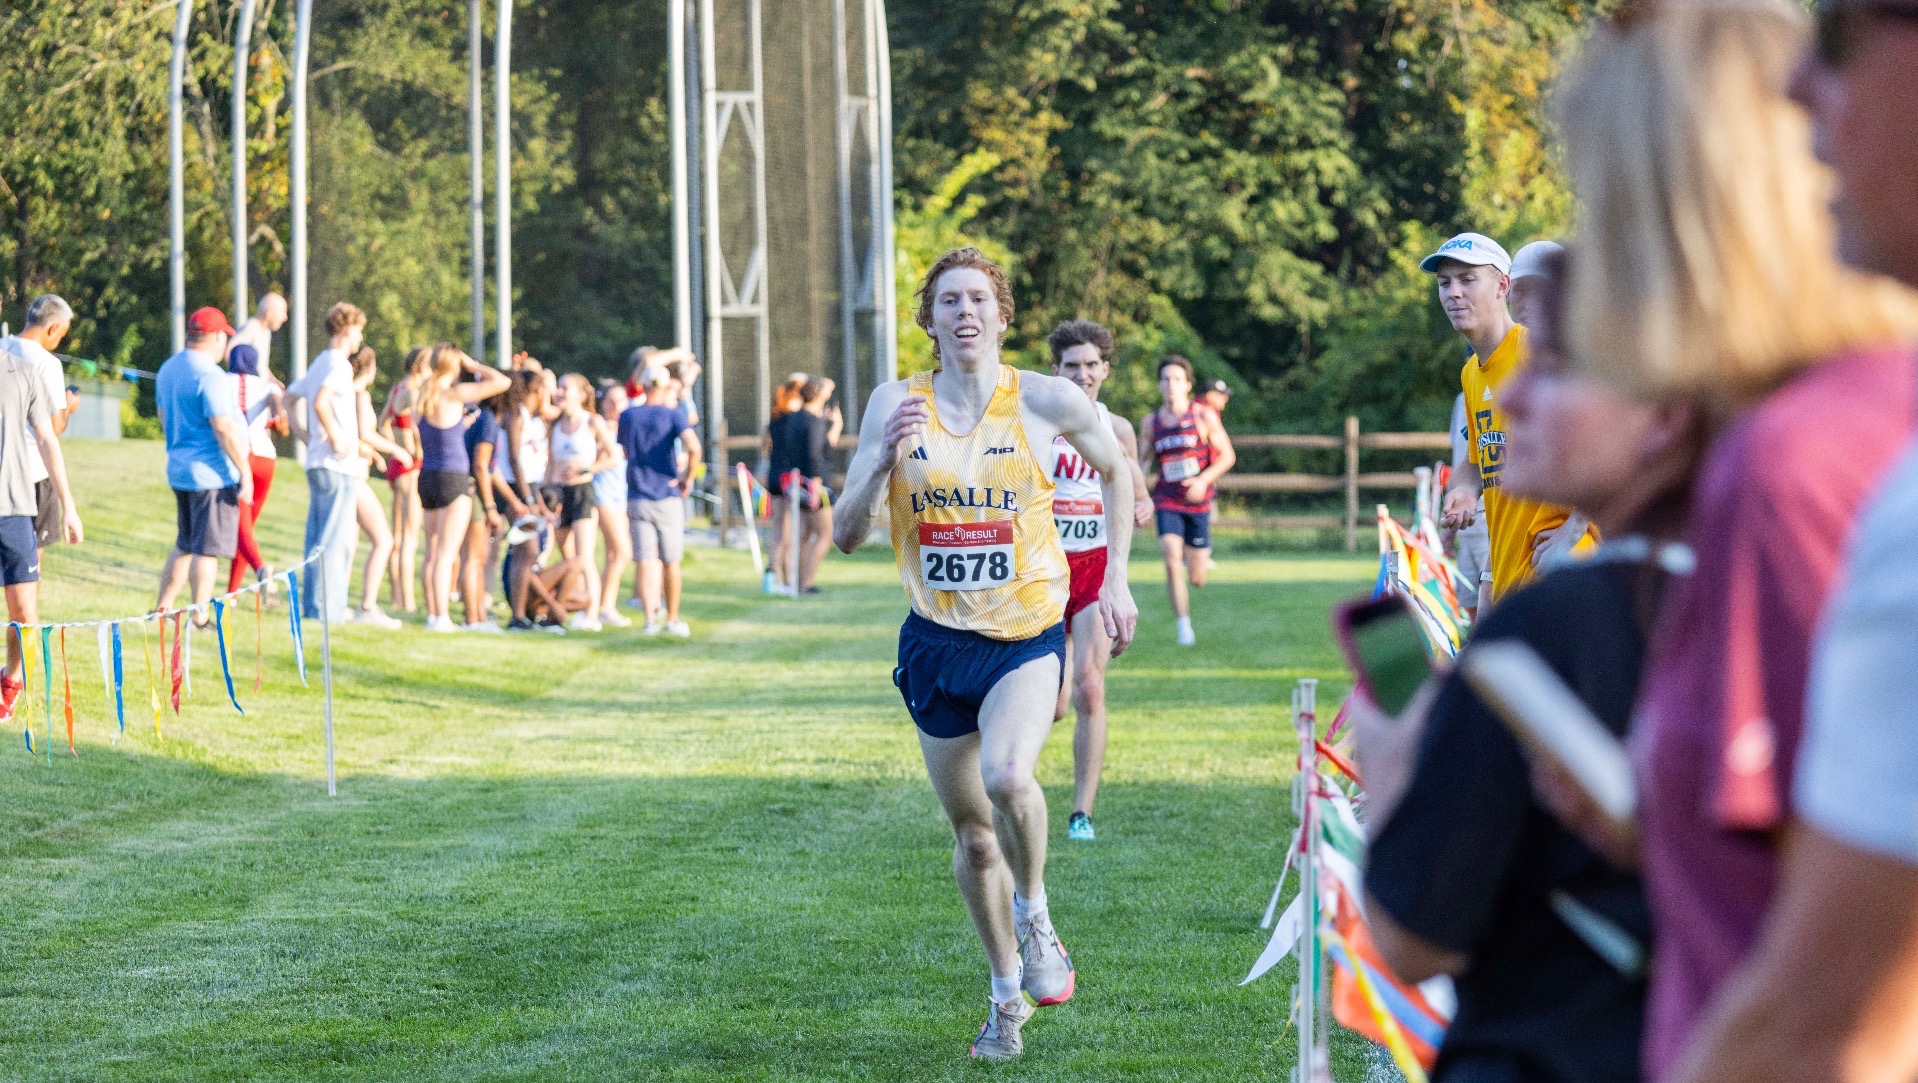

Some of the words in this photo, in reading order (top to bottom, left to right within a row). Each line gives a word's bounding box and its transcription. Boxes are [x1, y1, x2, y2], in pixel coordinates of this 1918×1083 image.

[909, 487, 1018, 514] LASALLE
[932, 531, 955, 540] RACE
[966, 529, 998, 540] RESULT
[1053, 519, 1098, 539] 703
[926, 551, 1009, 583] 2678
